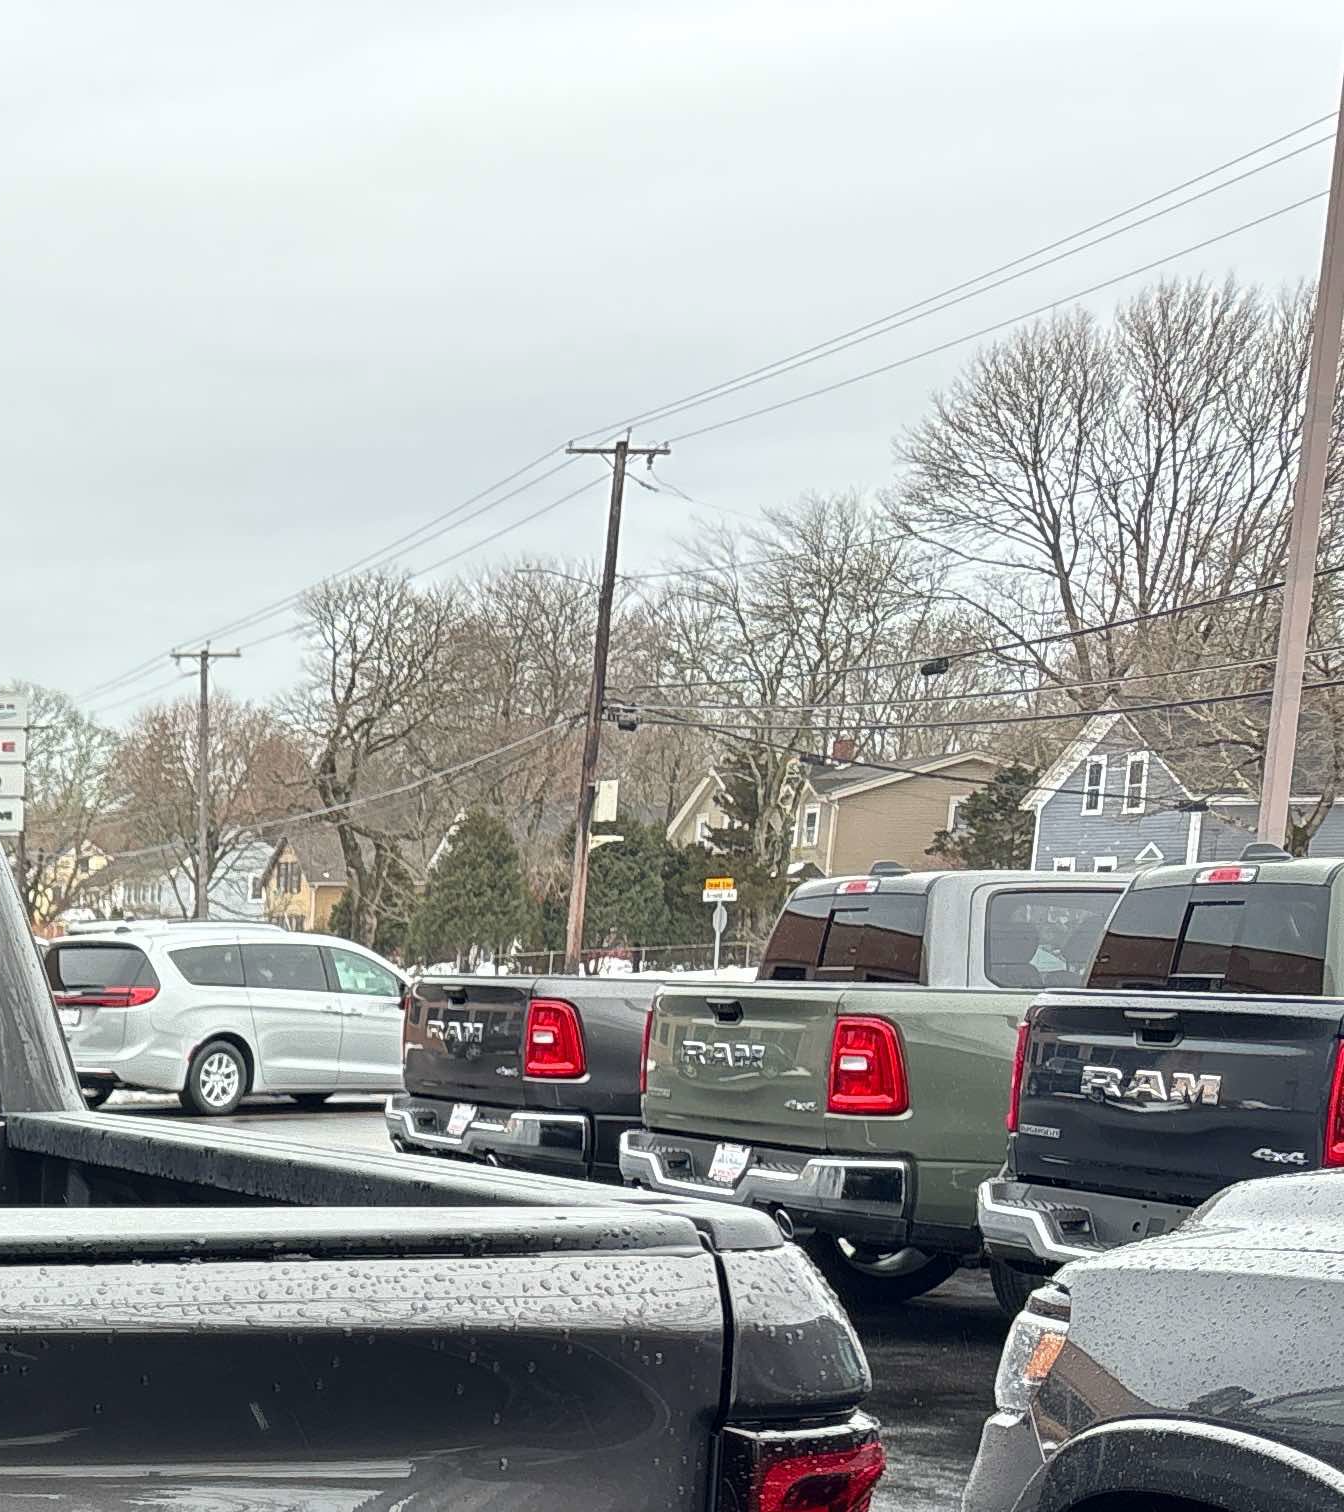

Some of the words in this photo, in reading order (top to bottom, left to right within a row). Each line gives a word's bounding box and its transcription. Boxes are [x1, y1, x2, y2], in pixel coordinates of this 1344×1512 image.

[427, 1020, 484, 1042] RAM
[681, 1040, 766, 1068] RAM
[1079, 1065, 1222, 1105] RAM
